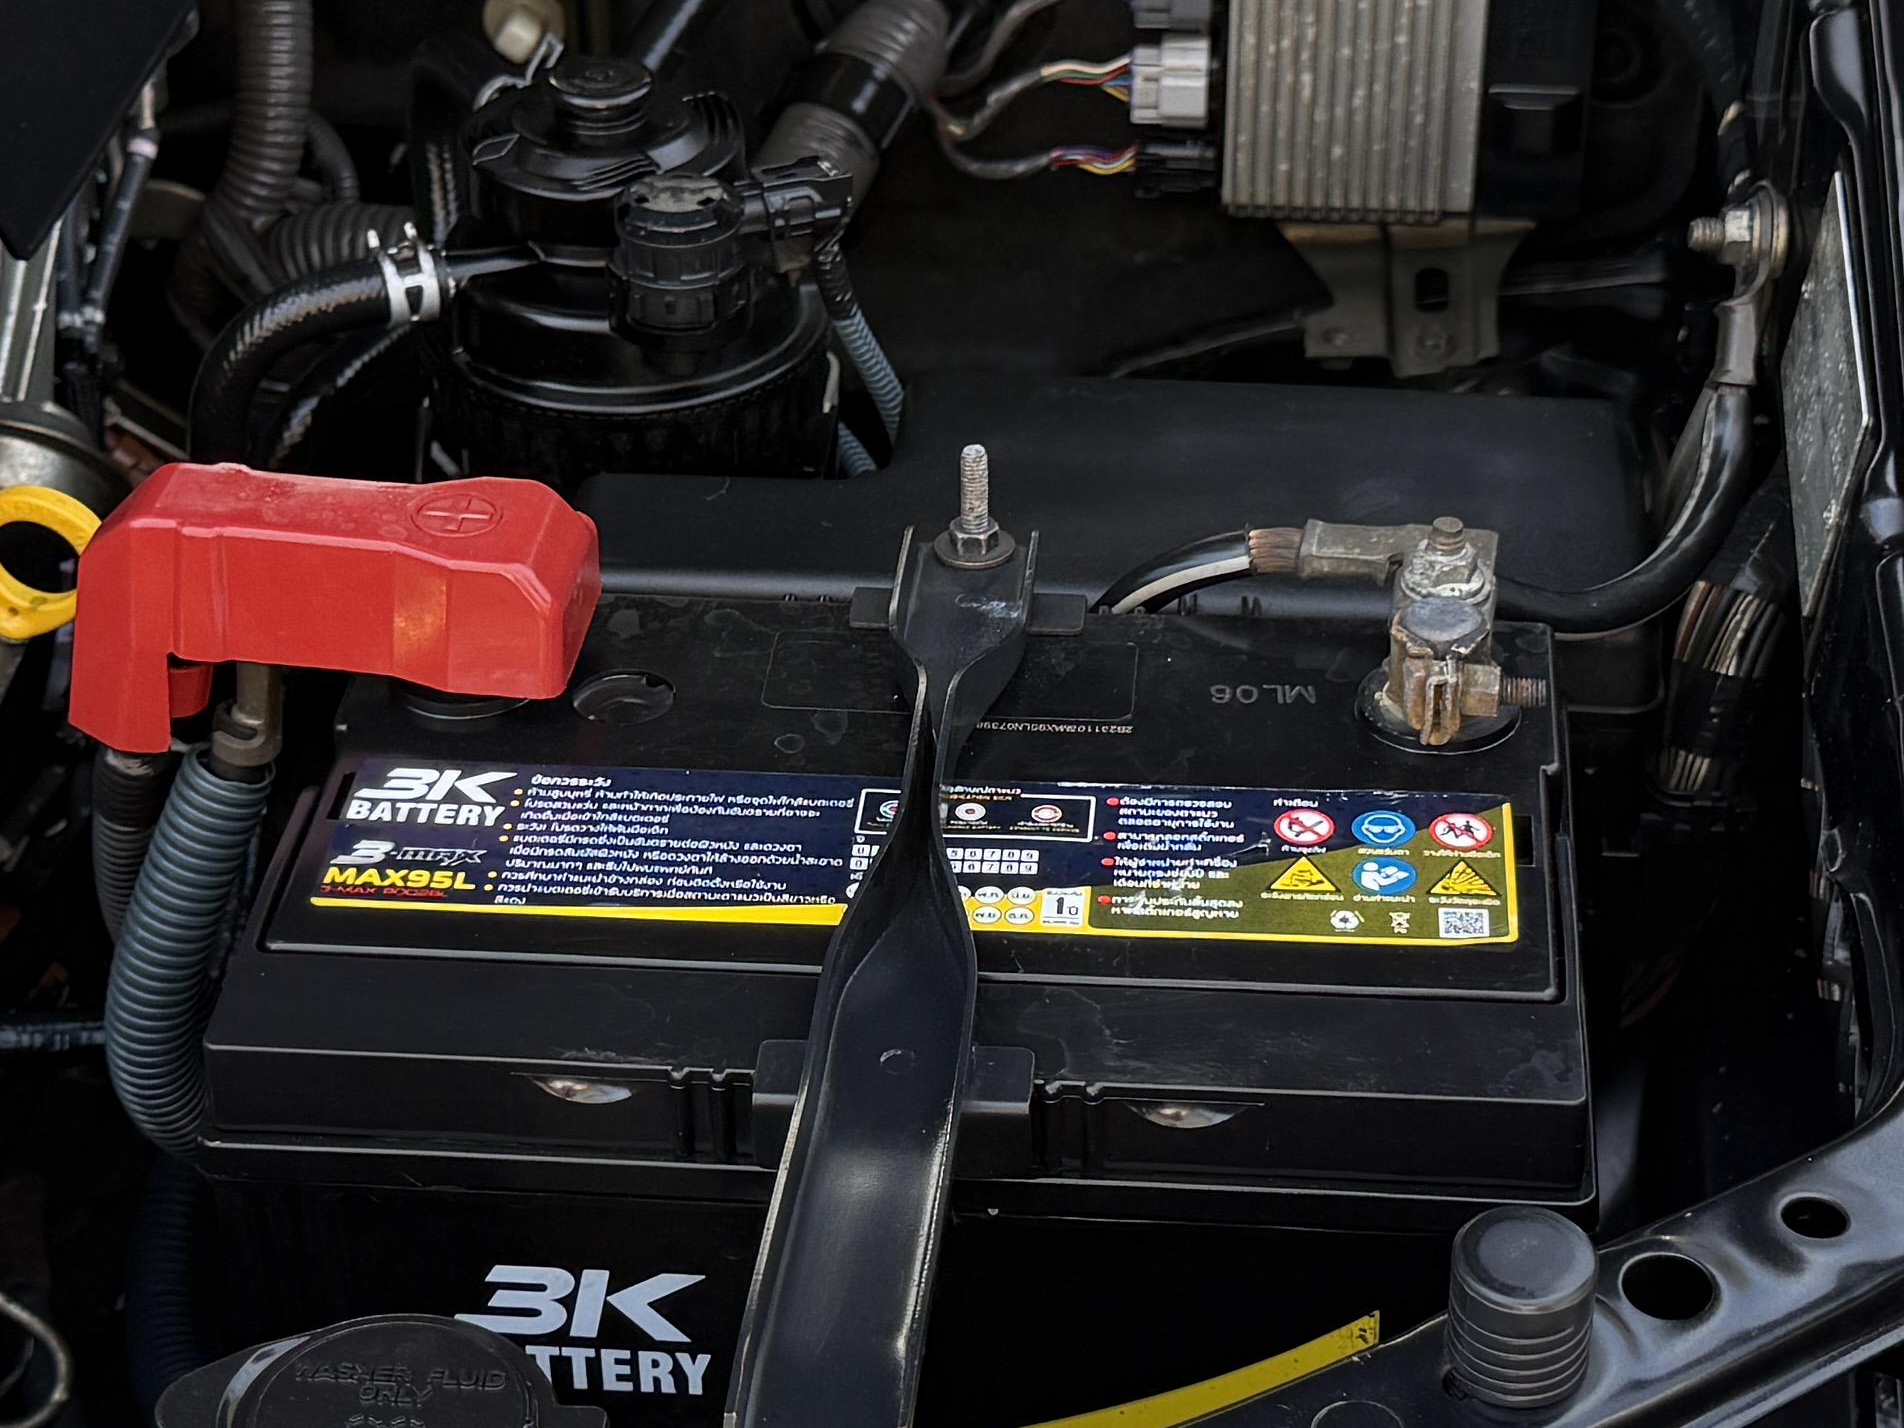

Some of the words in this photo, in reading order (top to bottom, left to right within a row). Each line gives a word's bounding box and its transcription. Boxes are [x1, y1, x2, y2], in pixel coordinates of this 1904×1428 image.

[1210, 684, 1317, 705] ML06
[353, 767, 518, 804] 3K
[346, 799, 506, 827] BATTERY
[322, 866, 477, 891] MAX95L
[453, 1264, 707, 1343] 3K
[295, 1362, 414, 1387] WASHER
[426, 1368, 508, 1391] FLUID
[524, 1344, 712, 1396] TTERY
[359, 1384, 434, 1408] ONLY
